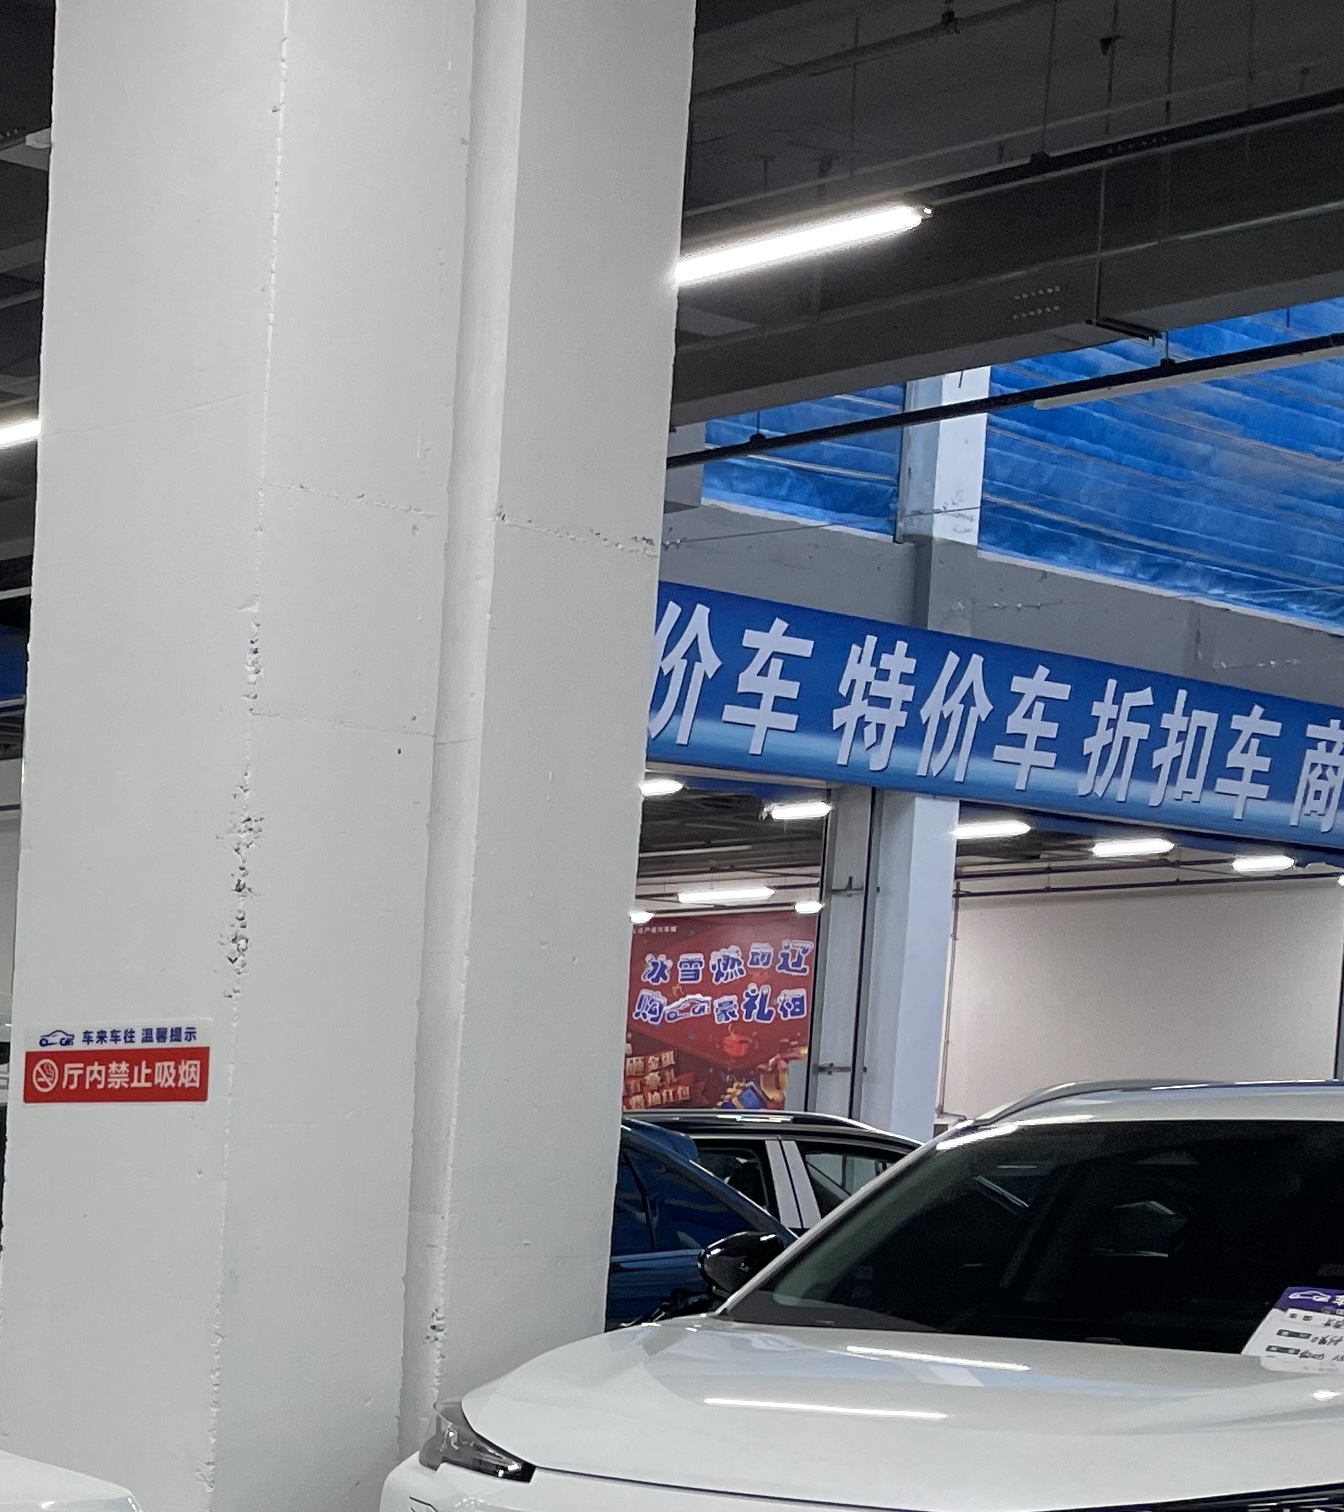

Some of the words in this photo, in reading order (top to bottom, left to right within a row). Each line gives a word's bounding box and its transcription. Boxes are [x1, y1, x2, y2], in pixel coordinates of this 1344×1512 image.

[832, 634, 1072, 791] 特价车
[1077, 678, 1282, 820] 折扣车
[82, 1028, 136, 1045] 车来车往
[141, 1027, 197, 1044] 温馨提示
[62, 1060, 201, 1090] 厅内禁止吸烟
